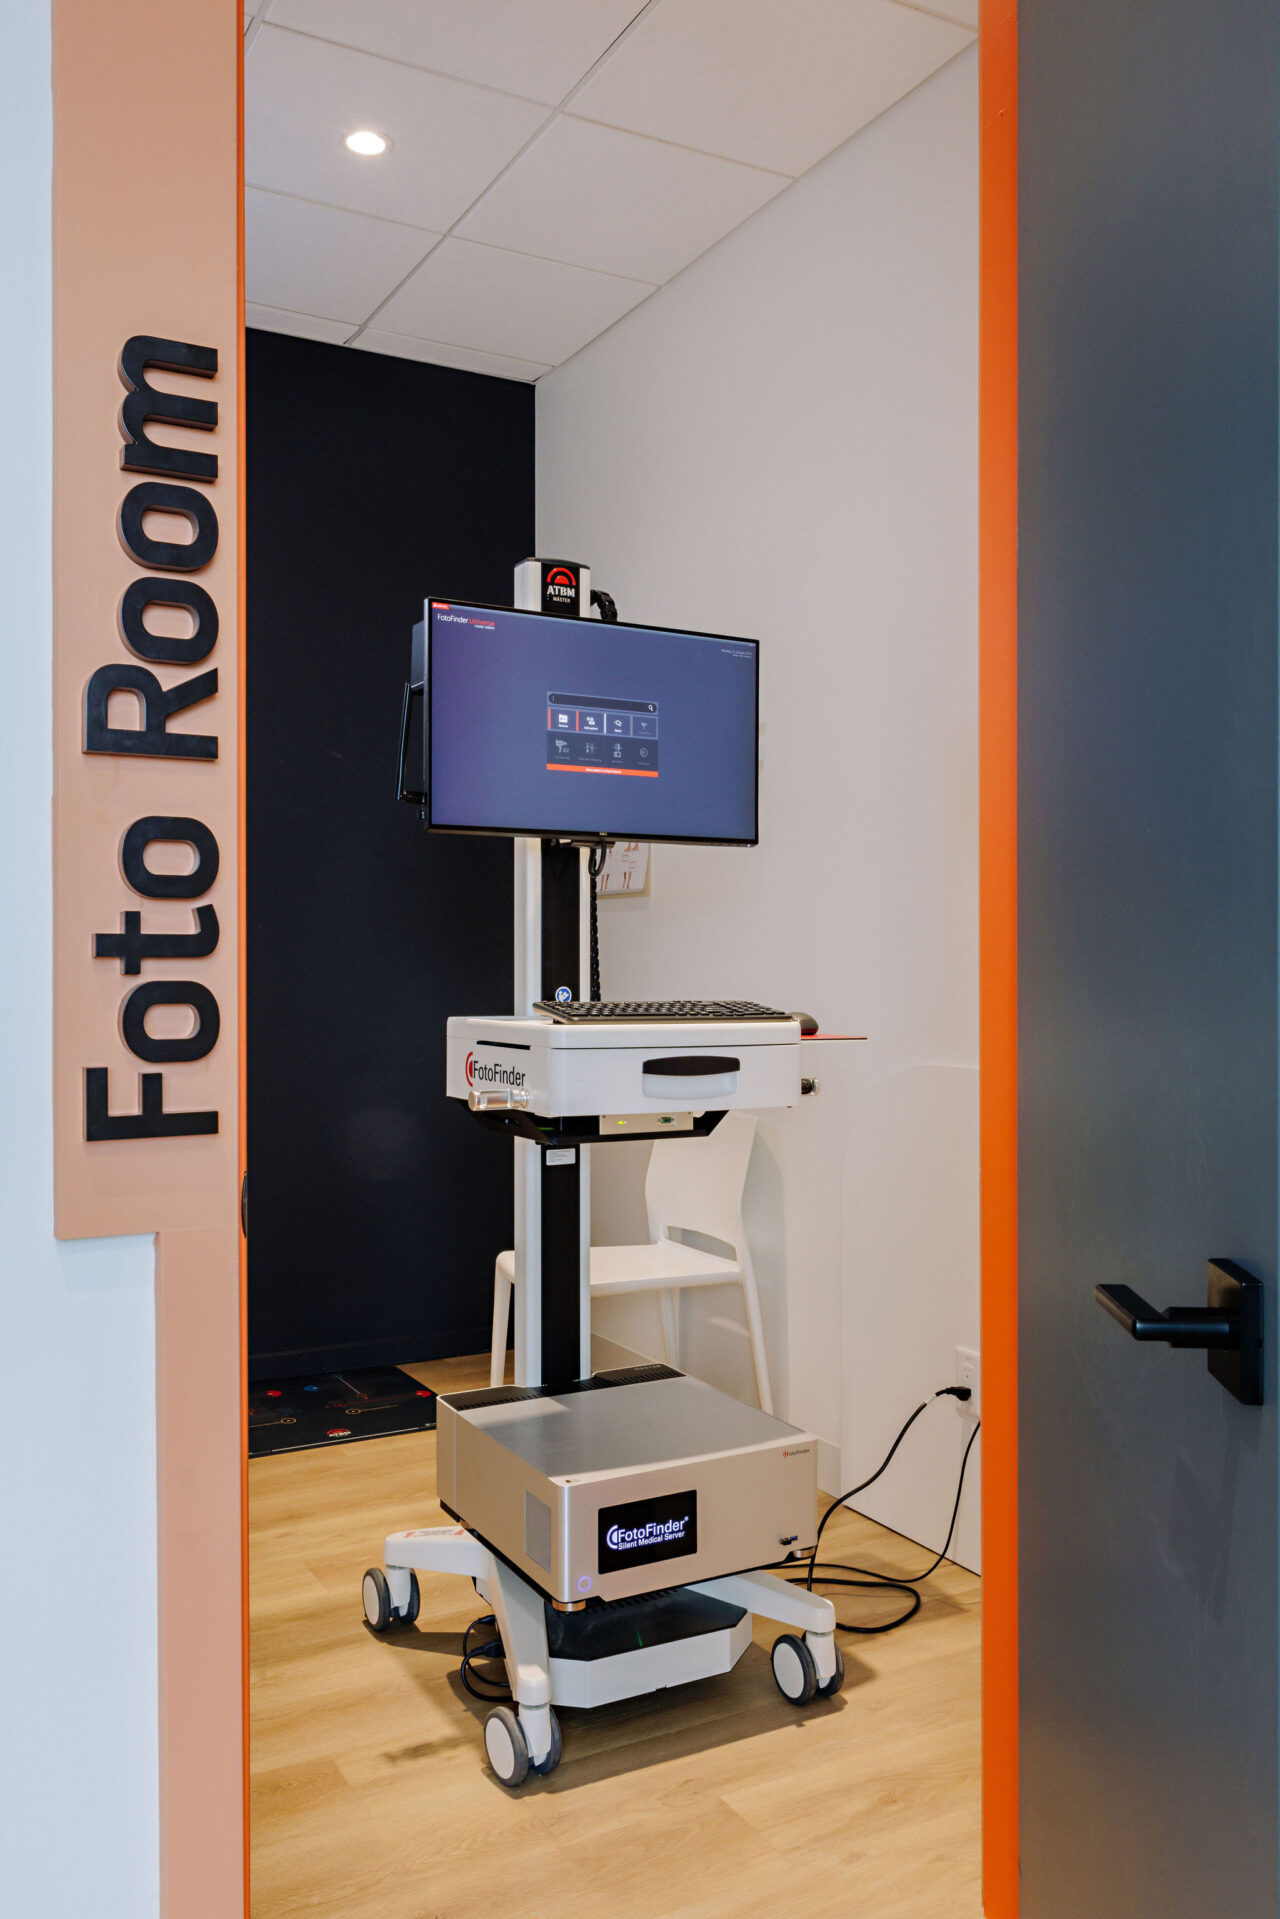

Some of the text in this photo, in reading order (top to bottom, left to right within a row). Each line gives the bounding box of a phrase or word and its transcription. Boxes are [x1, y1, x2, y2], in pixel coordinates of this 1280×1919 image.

[546, 585, 576, 598] ATBM
[82, 335, 220, 1142] Foto Room
[473, 1060, 526, 1087] FotoFinder
[618, 1531, 685, 1550] Silent Medical Server
